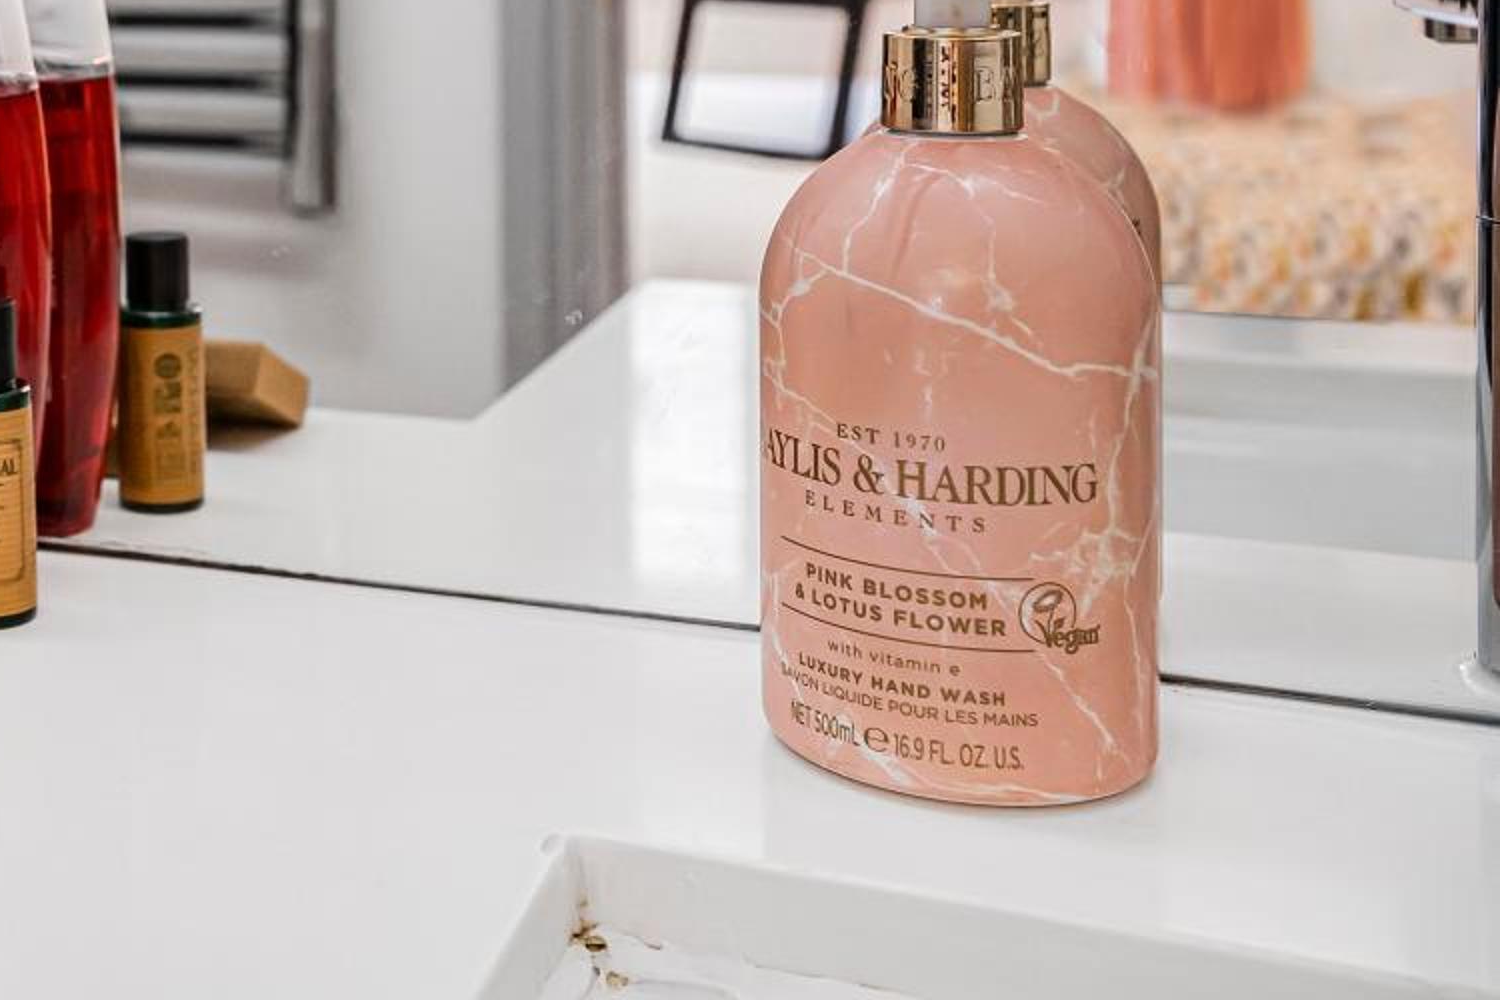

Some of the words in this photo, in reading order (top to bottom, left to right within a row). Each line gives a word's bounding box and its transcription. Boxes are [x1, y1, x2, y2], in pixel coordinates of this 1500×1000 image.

[836, 422, 881, 444] EST
[893, 431, 946, 451] 1970
[767, 428, 842, 487] AYLIS
[853, 453, 885, 495] &
[895, 459, 1099, 507] HARDING
[805, 489, 986, 534] ELEMENTS
[806, 562, 852, 591] PINK
[863, 578, 987, 611] BLOSSOM
[795, 583, 805, 600] &
[811, 589, 882, 622] LOTUS
[893, 609, 1007, 637] FLOWER
[799, 651, 864, 685] LUXURY
[871, 675, 931, 699] HAND
[940, 687, 1006, 707] WASH
[827, 640, 863, 660] with
[869, 651, 941, 674] vitamin
[949, 664, 961, 677] e
[791, 700, 813, 727] NET
[823, 682, 884, 711] LIQUIDE
[888, 698, 939, 721] POUR
[945, 709, 979, 725] LES
[983, 713, 1039, 728] MAINS
